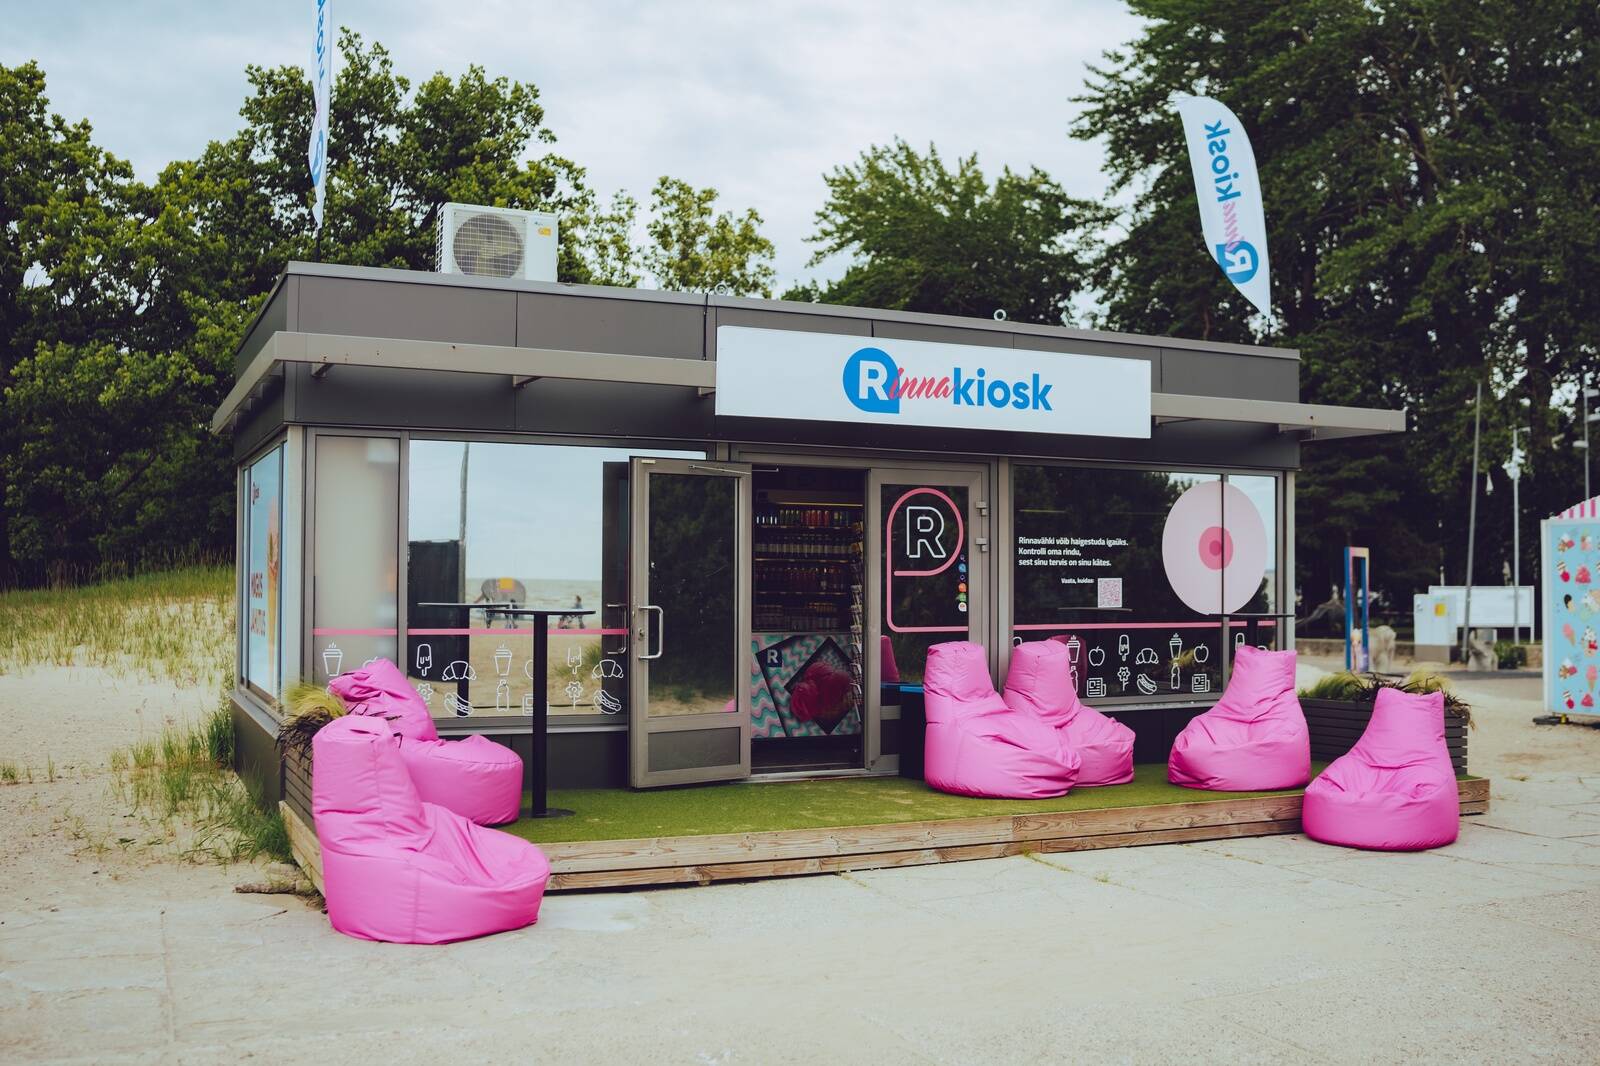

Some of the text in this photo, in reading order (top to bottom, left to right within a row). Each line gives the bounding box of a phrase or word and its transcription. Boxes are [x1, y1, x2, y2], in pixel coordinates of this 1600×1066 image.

[906, 506, 946, 558] R
[1018, 536, 1129, 547] Rinnavähki võib haigestuda igaüks.
[1018, 547, 1047, 555] Kontrolli
[1063, 548, 1082, 556] rindu,
[1018, 558, 1033, 566] sest
[1034, 558, 1048, 566] sinu
[1049, 558, 1068, 566] tervis
[1078, 559, 1092, 567] sinu
[1092, 558, 1112, 567] kätes.
[767, 650, 778, 663] R
